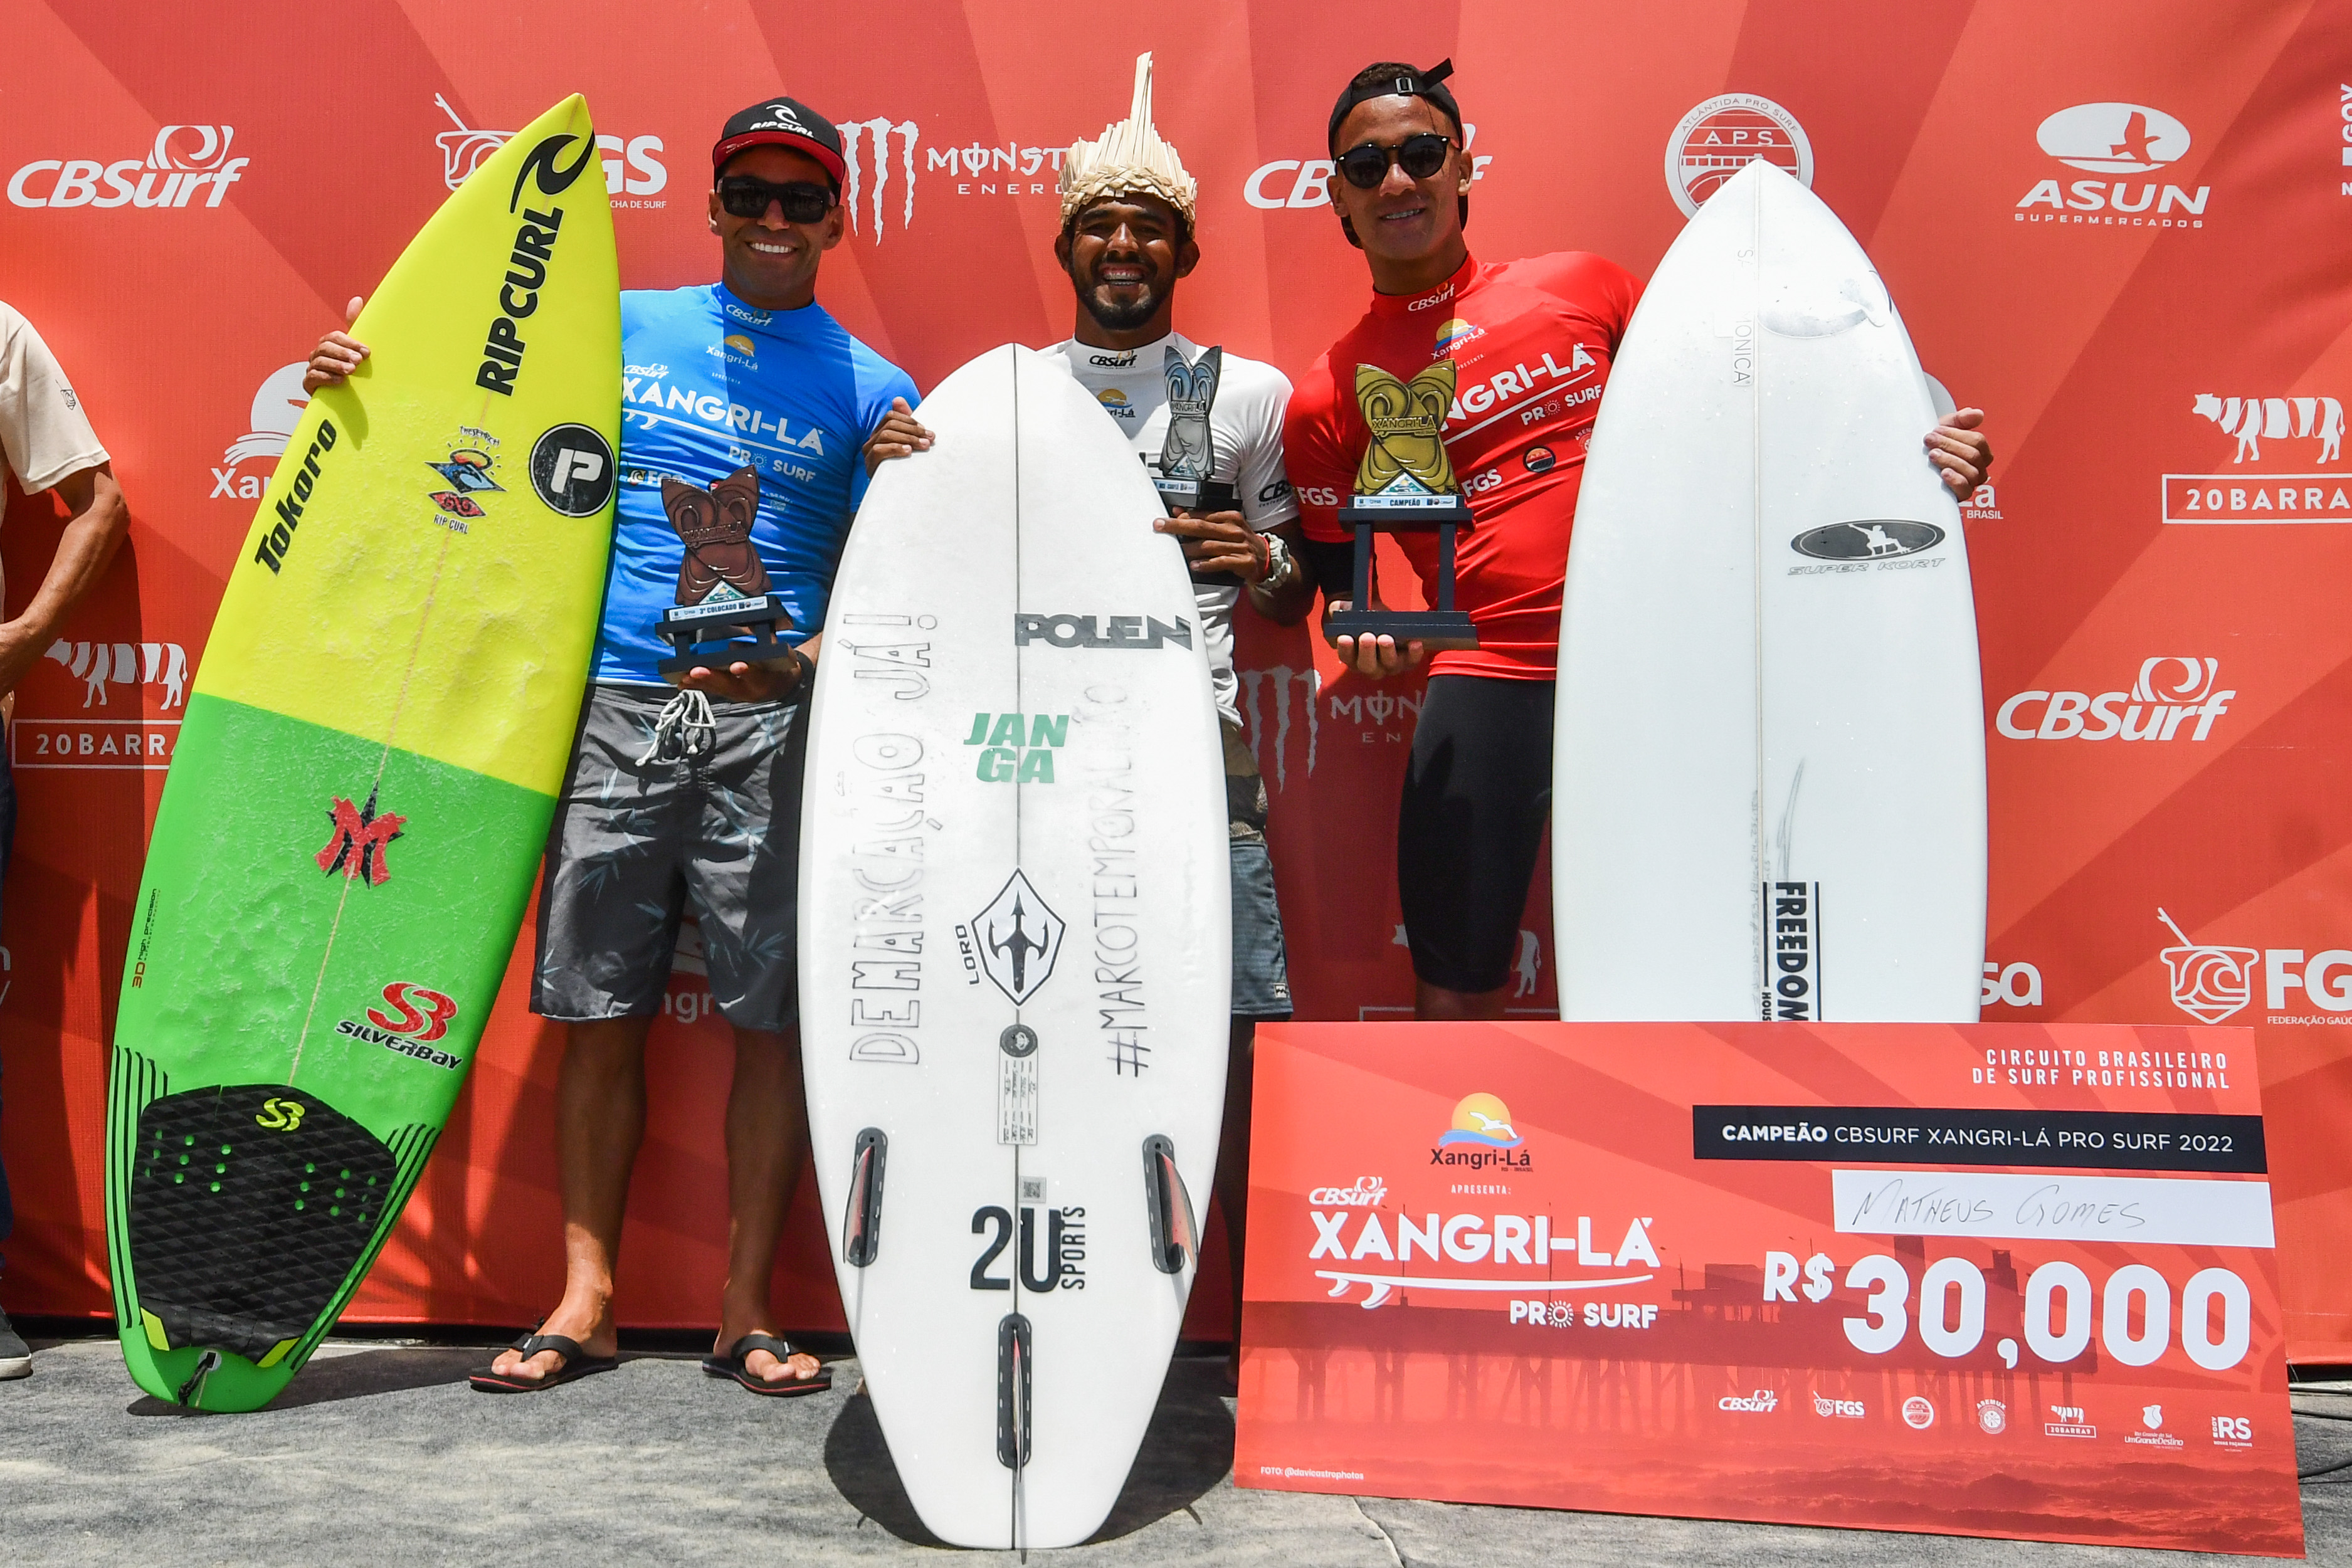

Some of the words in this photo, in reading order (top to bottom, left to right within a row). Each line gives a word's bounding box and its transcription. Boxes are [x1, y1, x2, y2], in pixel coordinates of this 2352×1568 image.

[1682, 98, 1740, 133] ATLÂNTIDA
[1745, 98, 1769, 110] PRO
[1773, 108, 1798, 132] SURF
[1704, 130, 1774, 146] APS
[7, 156, 250, 208] CBSurf
[643, 200, 667, 208] SURF
[2015, 179, 2211, 215] ASUN
[2014, 213, 2203, 228] SUPERMERCADOS
[1408, 284, 1455, 312] CBSurf
[725, 303, 773, 327] CBSurf
[1430, 327, 1485, 360] Xangri-Lá
[706, 345, 759, 371] Xangri-Lá
[1089, 354, 1138, 367] CBSurf
[623, 364, 669, 379] CBSurf
[1564, 384, 1602, 408] SURF
[621, 376, 825, 456] XANGRI-LÁ
[772, 459, 816, 483] SURF
[1461, 468, 1502, 498] FGS
[254, 418, 337, 576] Tokoro
[1296, 487, 1339, 505] FGS
[1389, 497, 1421, 507] CAMPEÃO
[2186, 487, 2351, 510] 20BARRA
[434, 514, 448, 526] RIP
[449, 519, 469, 534] CURL
[1966, 510, 2004, 520] BRASIL
[1787, 562, 1869, 576] SUPER
[1877, 557, 1946, 571] KORT
[707, 602, 737, 614] COLOCADO
[1015, 613, 1193, 651] POLEN
[1995, 690, 2236, 741] CBSurf
[964, 712, 1070, 747] JAN
[36, 733, 175, 755] 20BARR
[975, 747, 1055, 784] GA
[144, 888, 157, 935] precision
[137, 939, 146, 960] high
[954, 923, 979, 986] LORD
[132, 961, 146, 989] 3D
[2267, 1014, 2326, 1027] FEDERAÇÃO
[1986, 1049, 2086, 1067] CIRCUITO
[2099, 1050, 2228, 1070] BRASILEIRO
[1972, 1068, 1994, 1085] DE
[2008, 1068, 2060, 1085] SURF
[2072, 1070, 2230, 1090] PROFISSIONAL
[1722, 1122, 1828, 1142] CAMPEÃO
[1834, 1126, 1920, 1144] CBSURF
[1927, 1127, 2051, 1148] XANGRI-LÁ
[2058, 1131, 2105, 1149] PRO
[2112, 1134, 2171, 1151] SURF
[2179, 1135, 2233, 1152] 2022
[1430, 1148, 1531, 1170] Xangri-Lá
[1308, 1187, 1388, 1206] CBSurf
[1451, 1184, 1511, 1195] APRESENTA:
[1060, 1205, 1086, 1290] SPORTS
[1309, 1210, 1661, 1268] XANGRI-LÁ
[1583, 1302, 1659, 1329] SURF
[1763, 1251, 1835, 1303] R$
[1842, 1254, 2251, 1371] 30,000
[1717, 1397, 1778, 1413] CBSurf
[1835, 1399, 1865, 1416] FGS
[2218, 1416, 2252, 1440] RS
[1260, 1466, 1284, 1475] FOTO:
